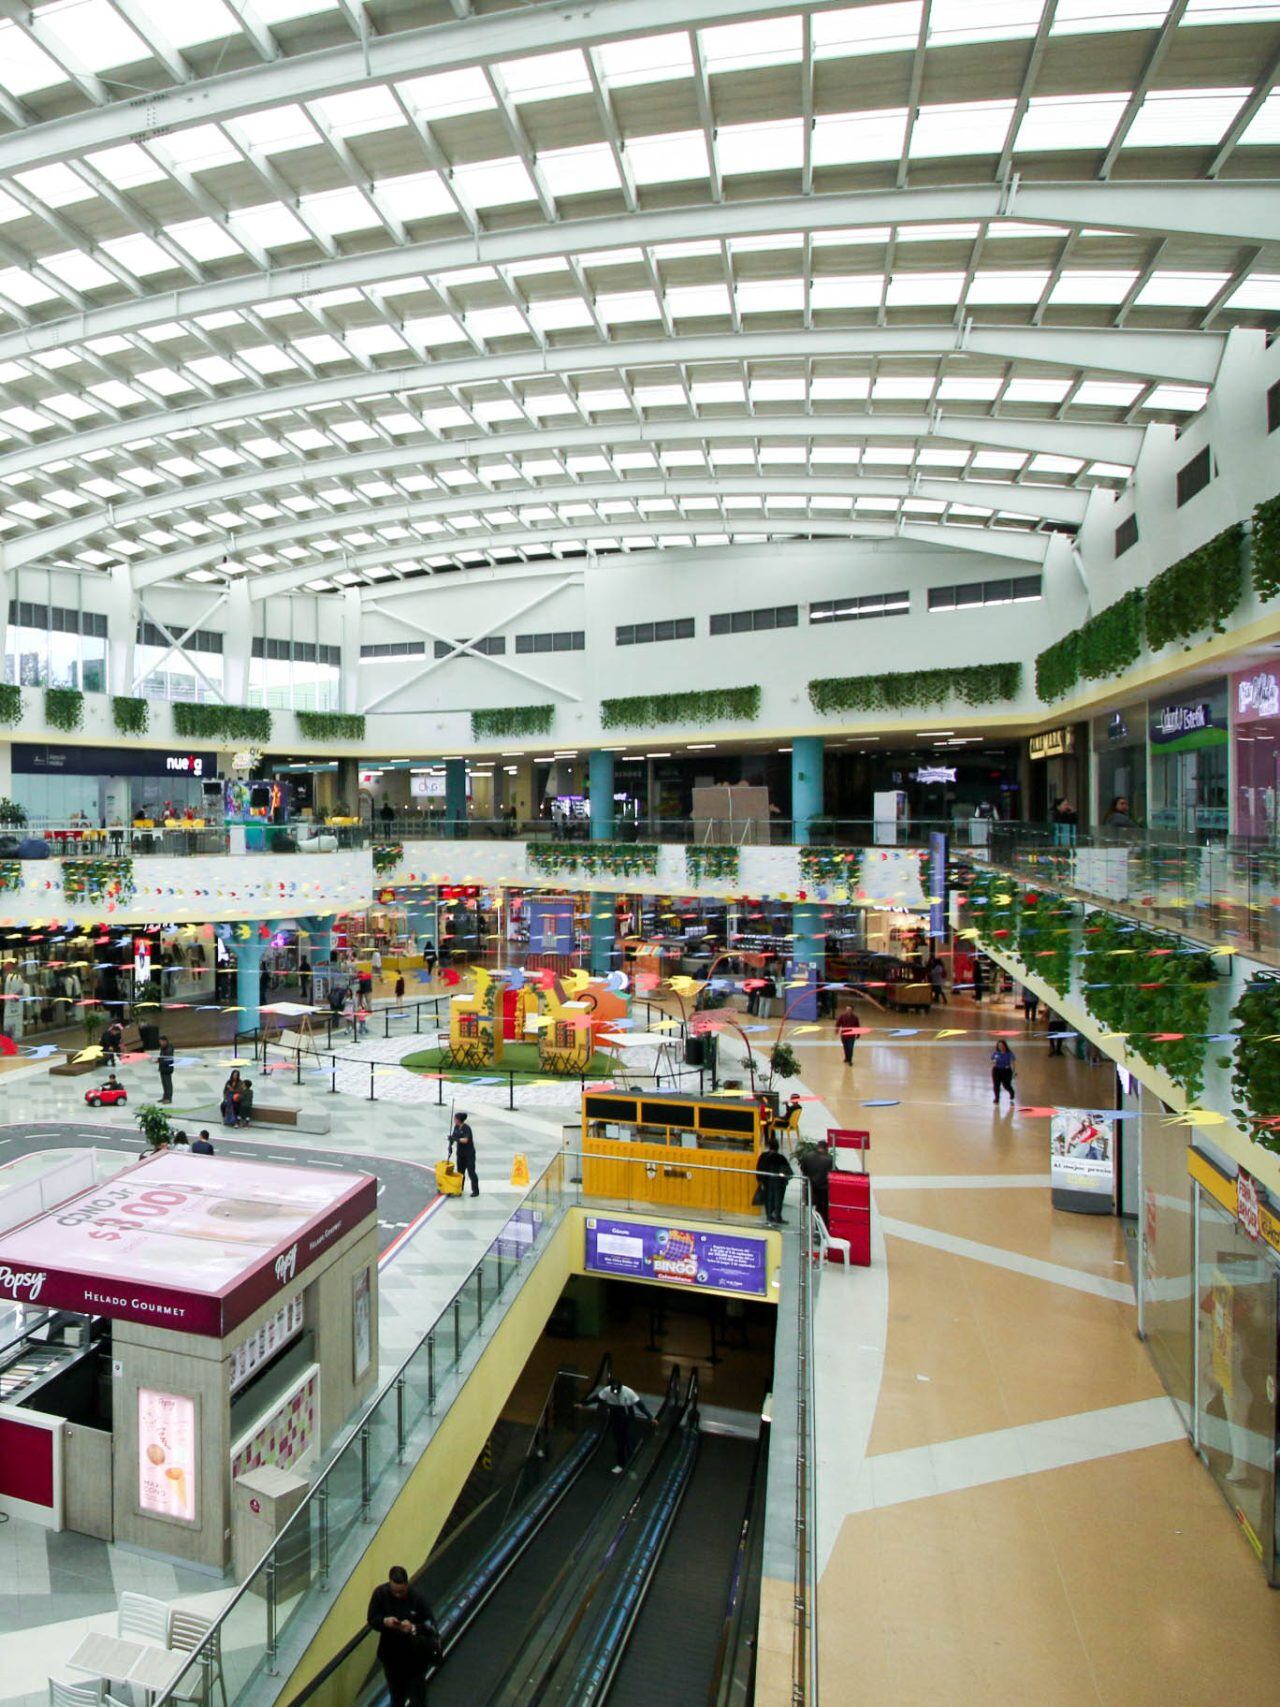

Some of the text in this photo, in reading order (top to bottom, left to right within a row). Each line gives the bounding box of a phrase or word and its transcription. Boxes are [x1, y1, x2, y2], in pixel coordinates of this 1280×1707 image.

[56, 1198, 116, 1227] CONO
[274, 1243, 298, 1285] Popsy
[653, 1260, 698, 1274] BINGO
[84, 1290, 128, 1307] HELADO
[131, 1299, 187, 1317] GOURMET
